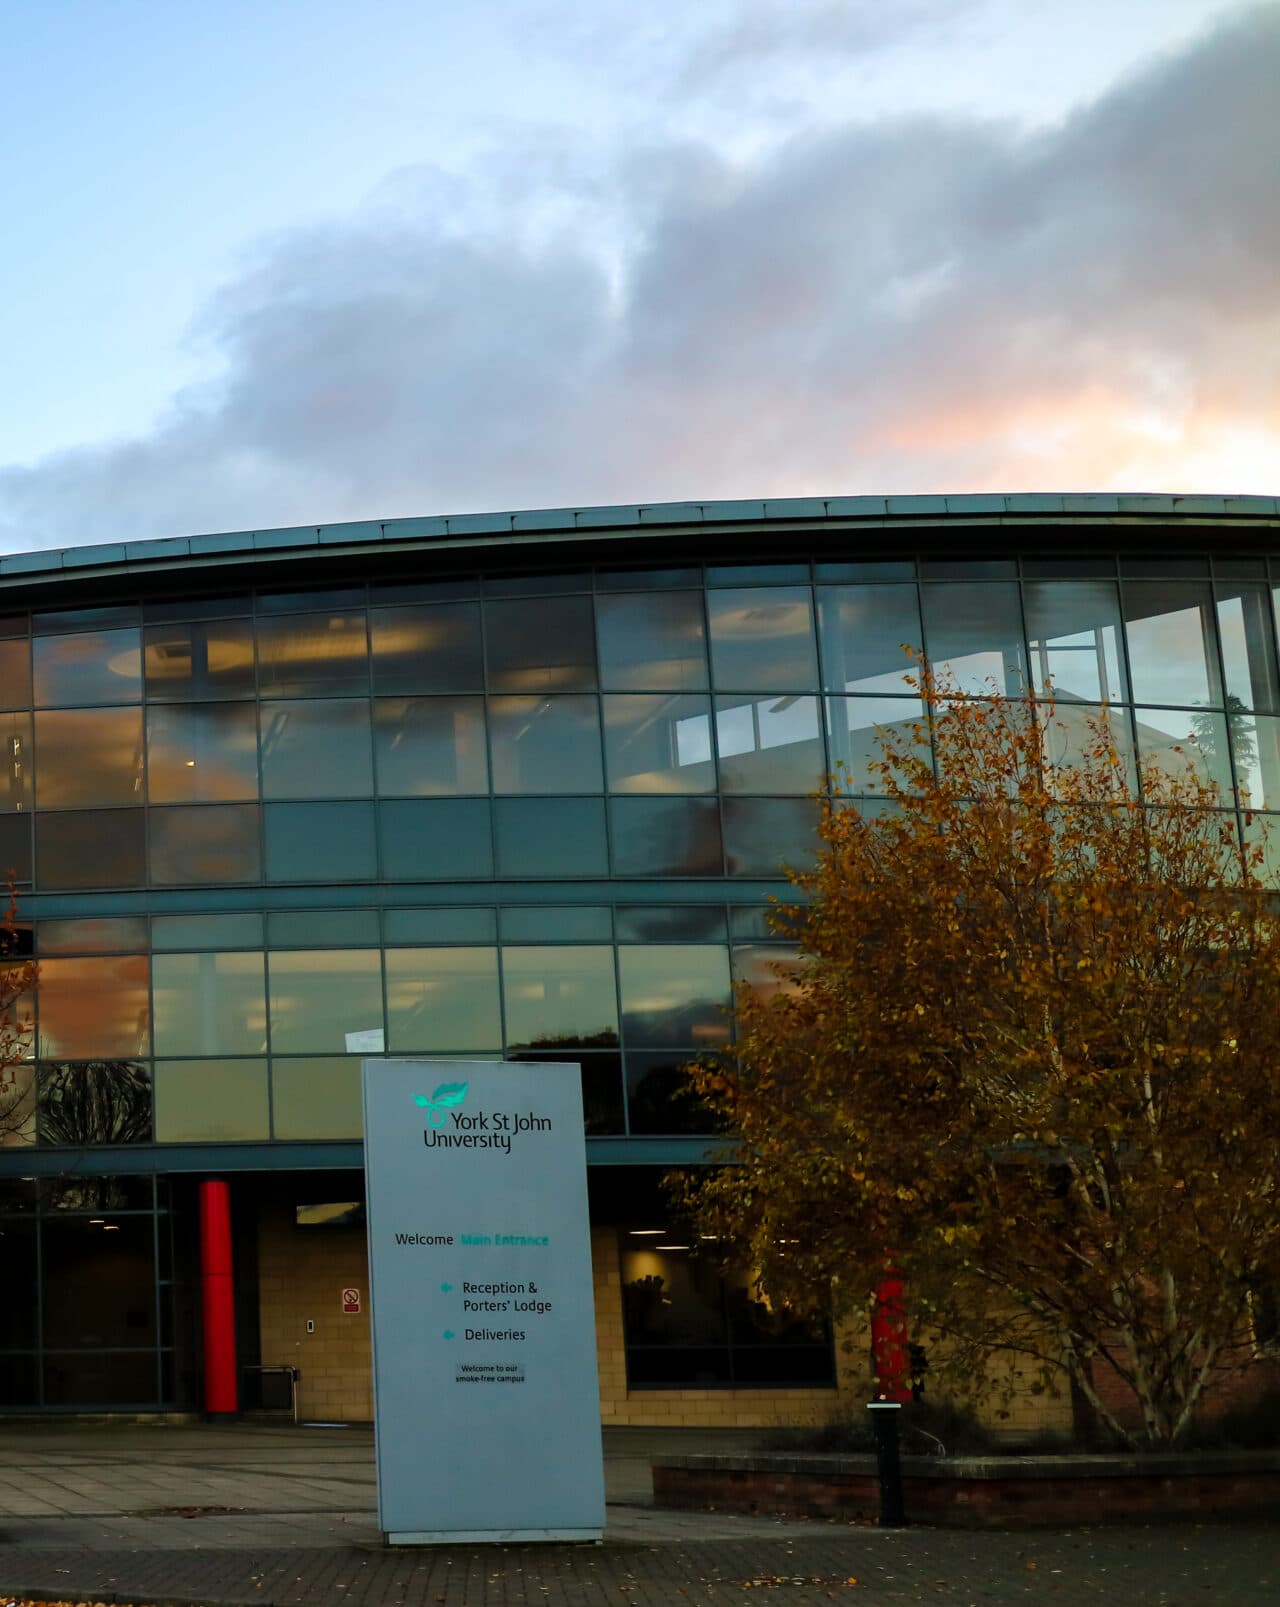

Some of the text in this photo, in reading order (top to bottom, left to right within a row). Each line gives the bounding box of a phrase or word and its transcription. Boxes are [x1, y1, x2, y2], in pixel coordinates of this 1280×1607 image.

[451, 1111, 552, 1135] York St John
[423, 1129, 512, 1154] University
[395, 1233, 549, 1246] Welcome Main Entrance
[463, 1281, 538, 1296] Reception &
[514, 1300, 552, 1315] Lodge
[464, 1328, 526, 1341] Deliveries
[461, 1365, 518, 1373] Welcome to our
[455, 1375, 525, 1384] smoke-free campus
